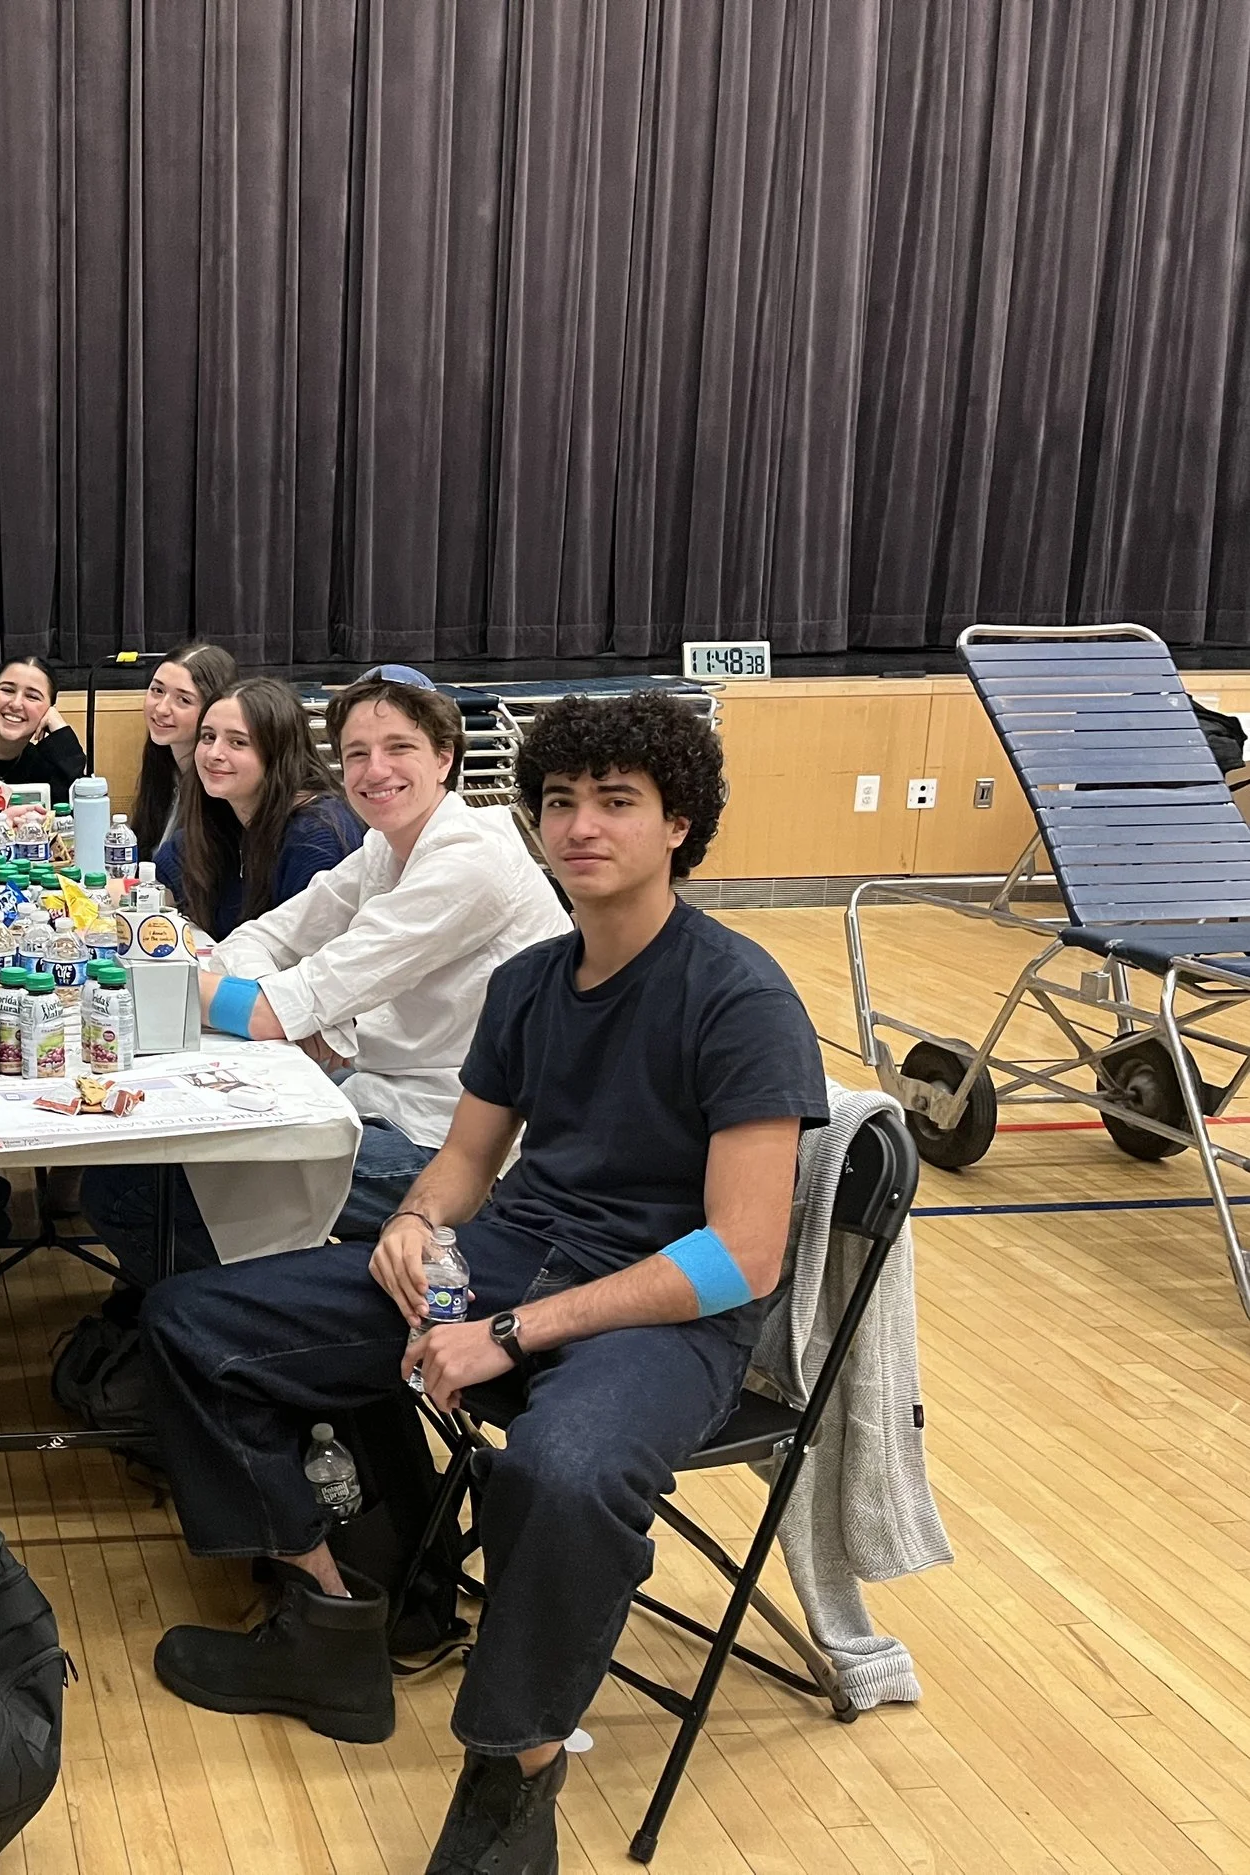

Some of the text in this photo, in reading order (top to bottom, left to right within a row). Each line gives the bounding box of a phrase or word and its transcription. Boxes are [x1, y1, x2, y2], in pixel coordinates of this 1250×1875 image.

[692, 647, 765, 675] 11:48 38
[54, 963, 73, 972] Pure
[57, 969, 72, 980] Life
[187, 1114, 226, 1122] YOU
